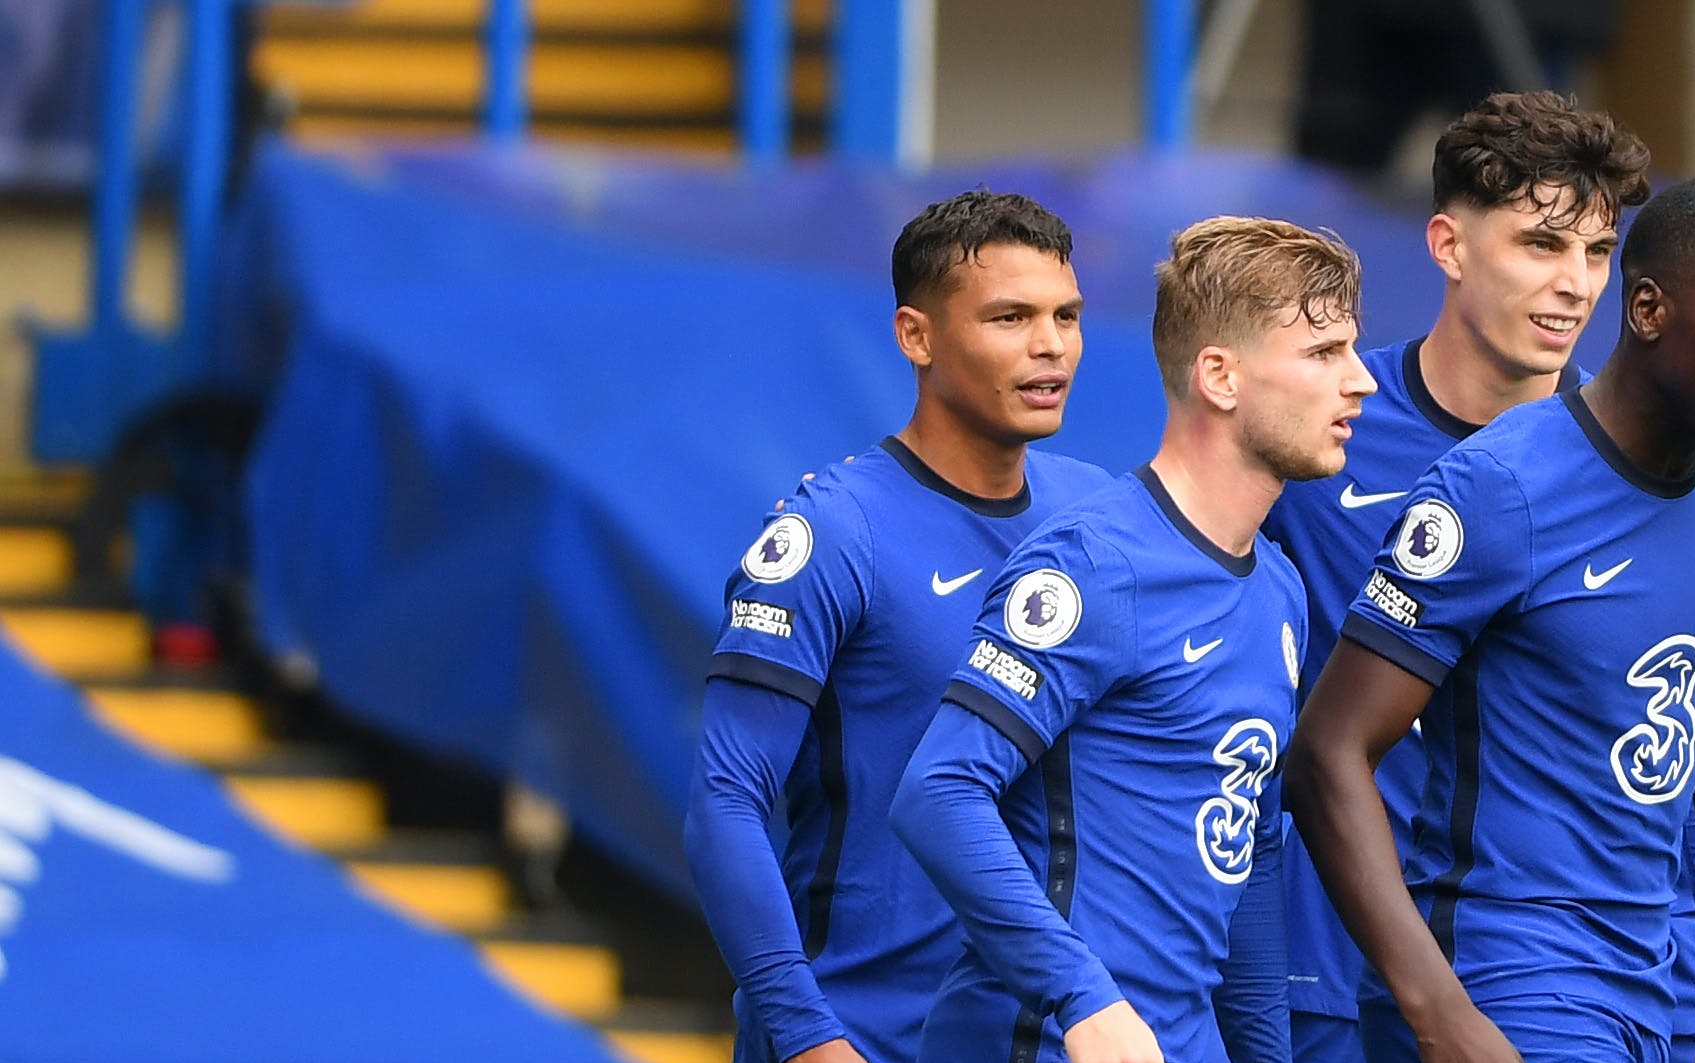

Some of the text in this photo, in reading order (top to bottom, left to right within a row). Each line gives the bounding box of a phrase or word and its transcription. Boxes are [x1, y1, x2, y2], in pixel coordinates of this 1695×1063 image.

[732, 599, 788, 623] No room
[1382, 581, 1418, 615] room
[974, 639, 1037, 685] No room
